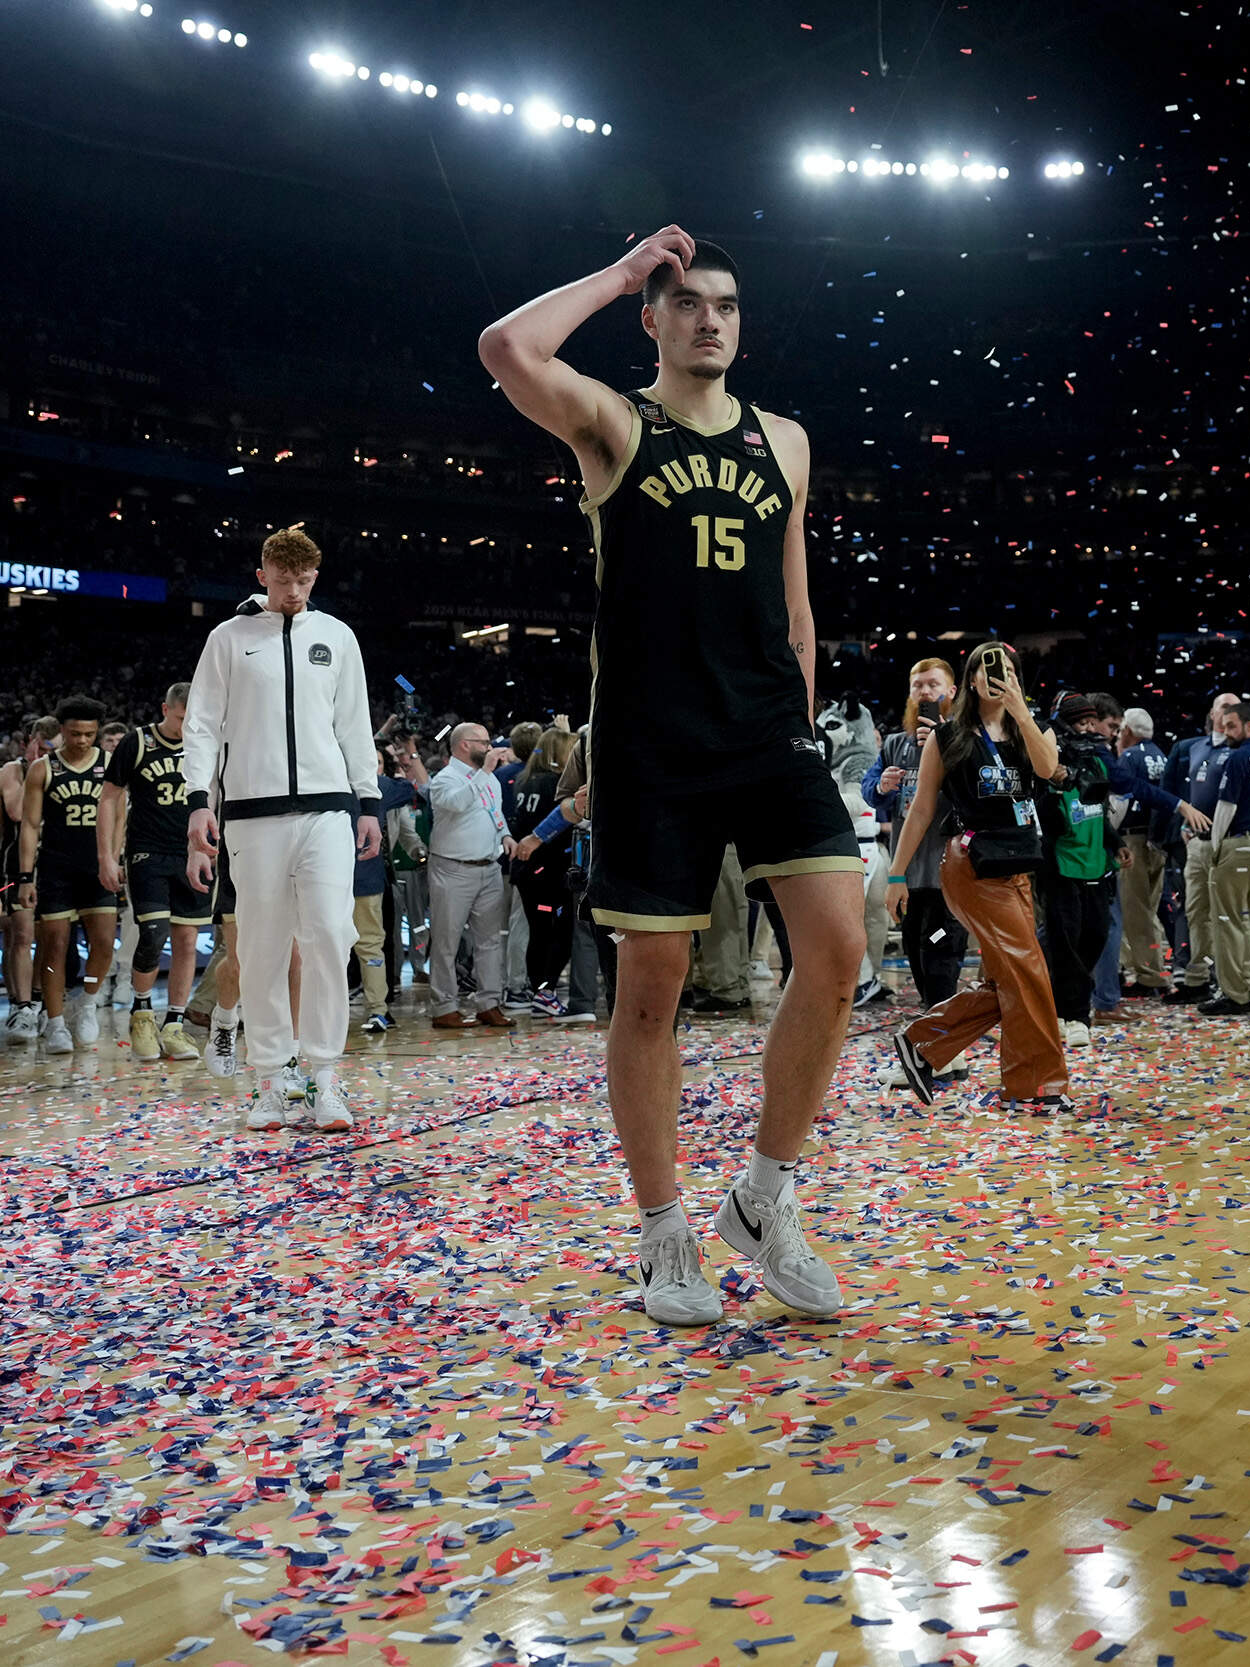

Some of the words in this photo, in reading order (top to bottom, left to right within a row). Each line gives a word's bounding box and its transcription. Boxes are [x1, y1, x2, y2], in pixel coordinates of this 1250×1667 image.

[639, 454, 783, 521] PURDUE
[691, 514, 745, 571] 15
[0, 561, 80, 591] USKIES
[157, 782, 188, 806] 34
[66, 804, 97, 826] 22
